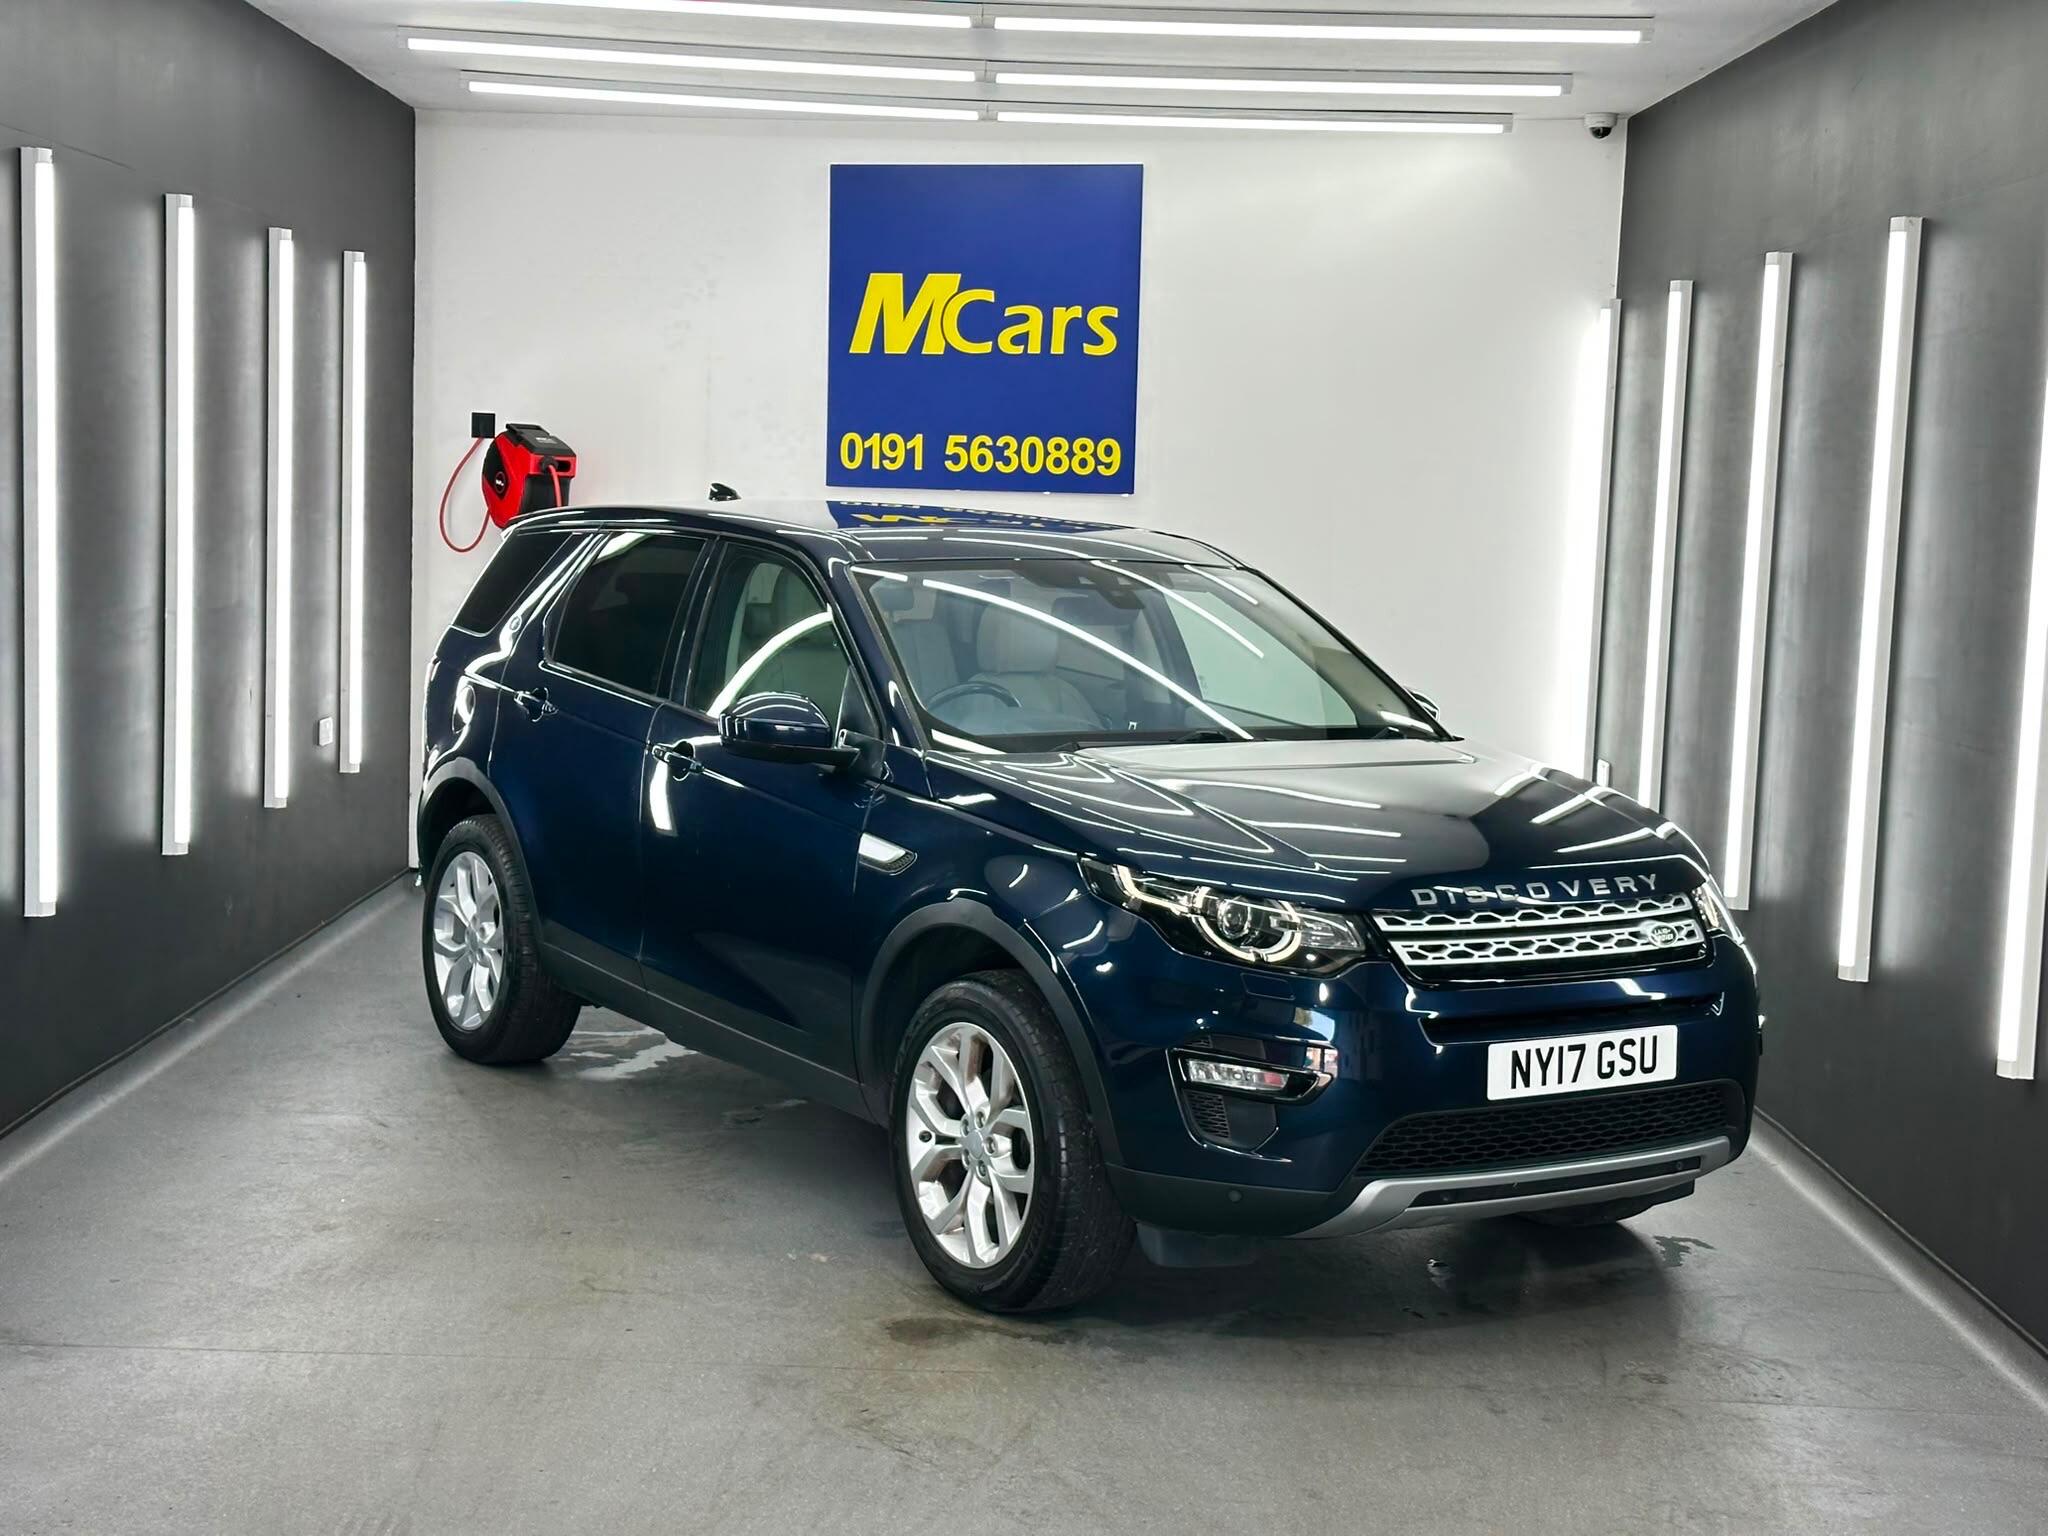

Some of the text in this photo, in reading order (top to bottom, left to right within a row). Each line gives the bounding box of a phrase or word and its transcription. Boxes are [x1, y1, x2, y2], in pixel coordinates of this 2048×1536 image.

[849, 272, 1119, 356] MCars
[839, 432, 1121, 476] 0191 5630889
[1410, 873, 1657, 906] DISCOVERY
[1510, 1035, 1658, 1090] NY17 GSU
